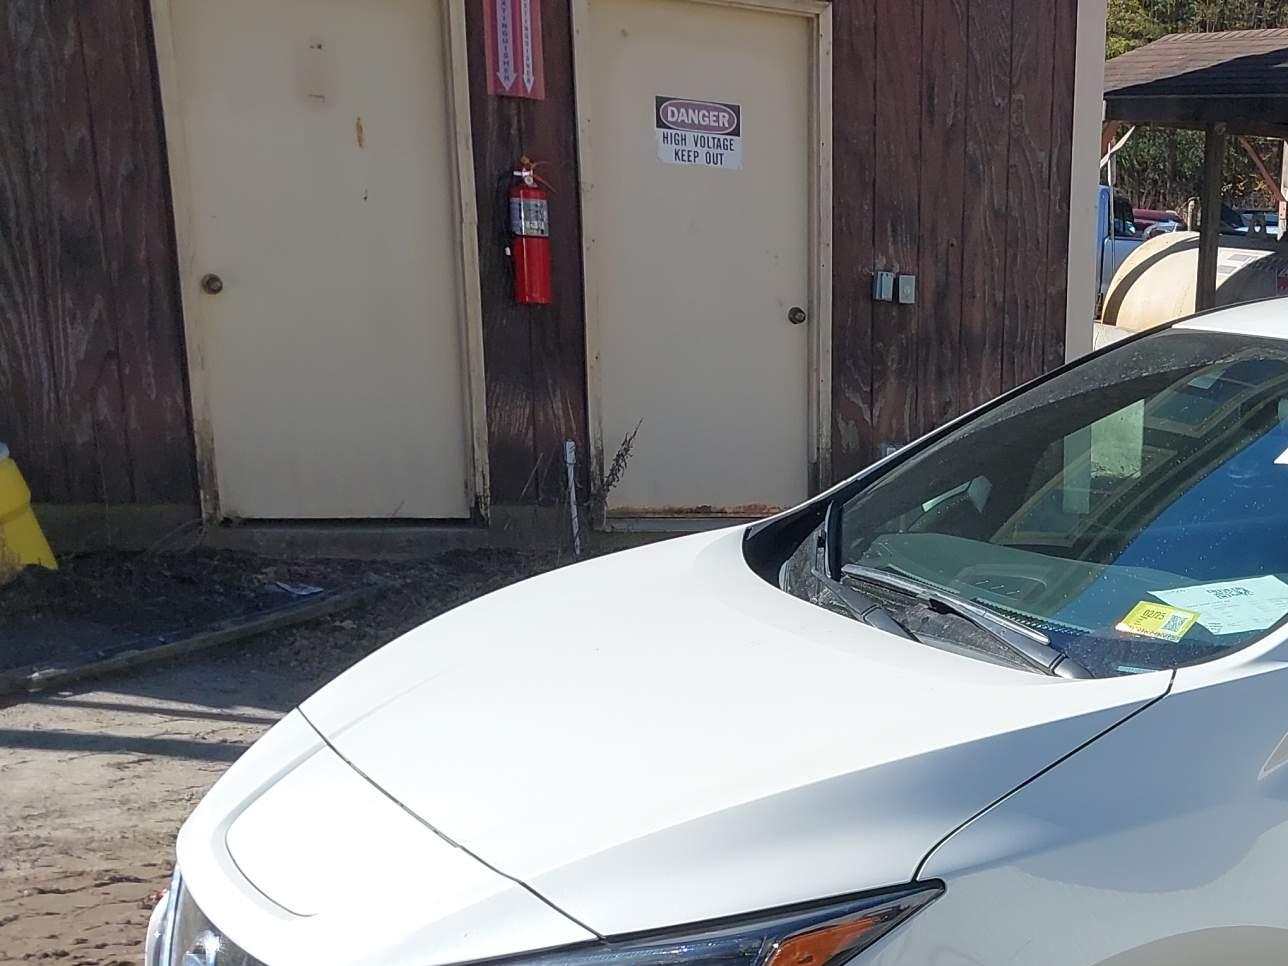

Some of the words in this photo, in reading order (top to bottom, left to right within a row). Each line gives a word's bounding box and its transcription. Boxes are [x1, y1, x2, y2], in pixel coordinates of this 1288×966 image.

[667, 106, 729, 127] DANGER
[662, 131, 687, 145] HIGH
[693, 135, 735, 151] VOLTAGE
[674, 149, 699, 163] KEEP
[705, 151, 724, 165] OUT
